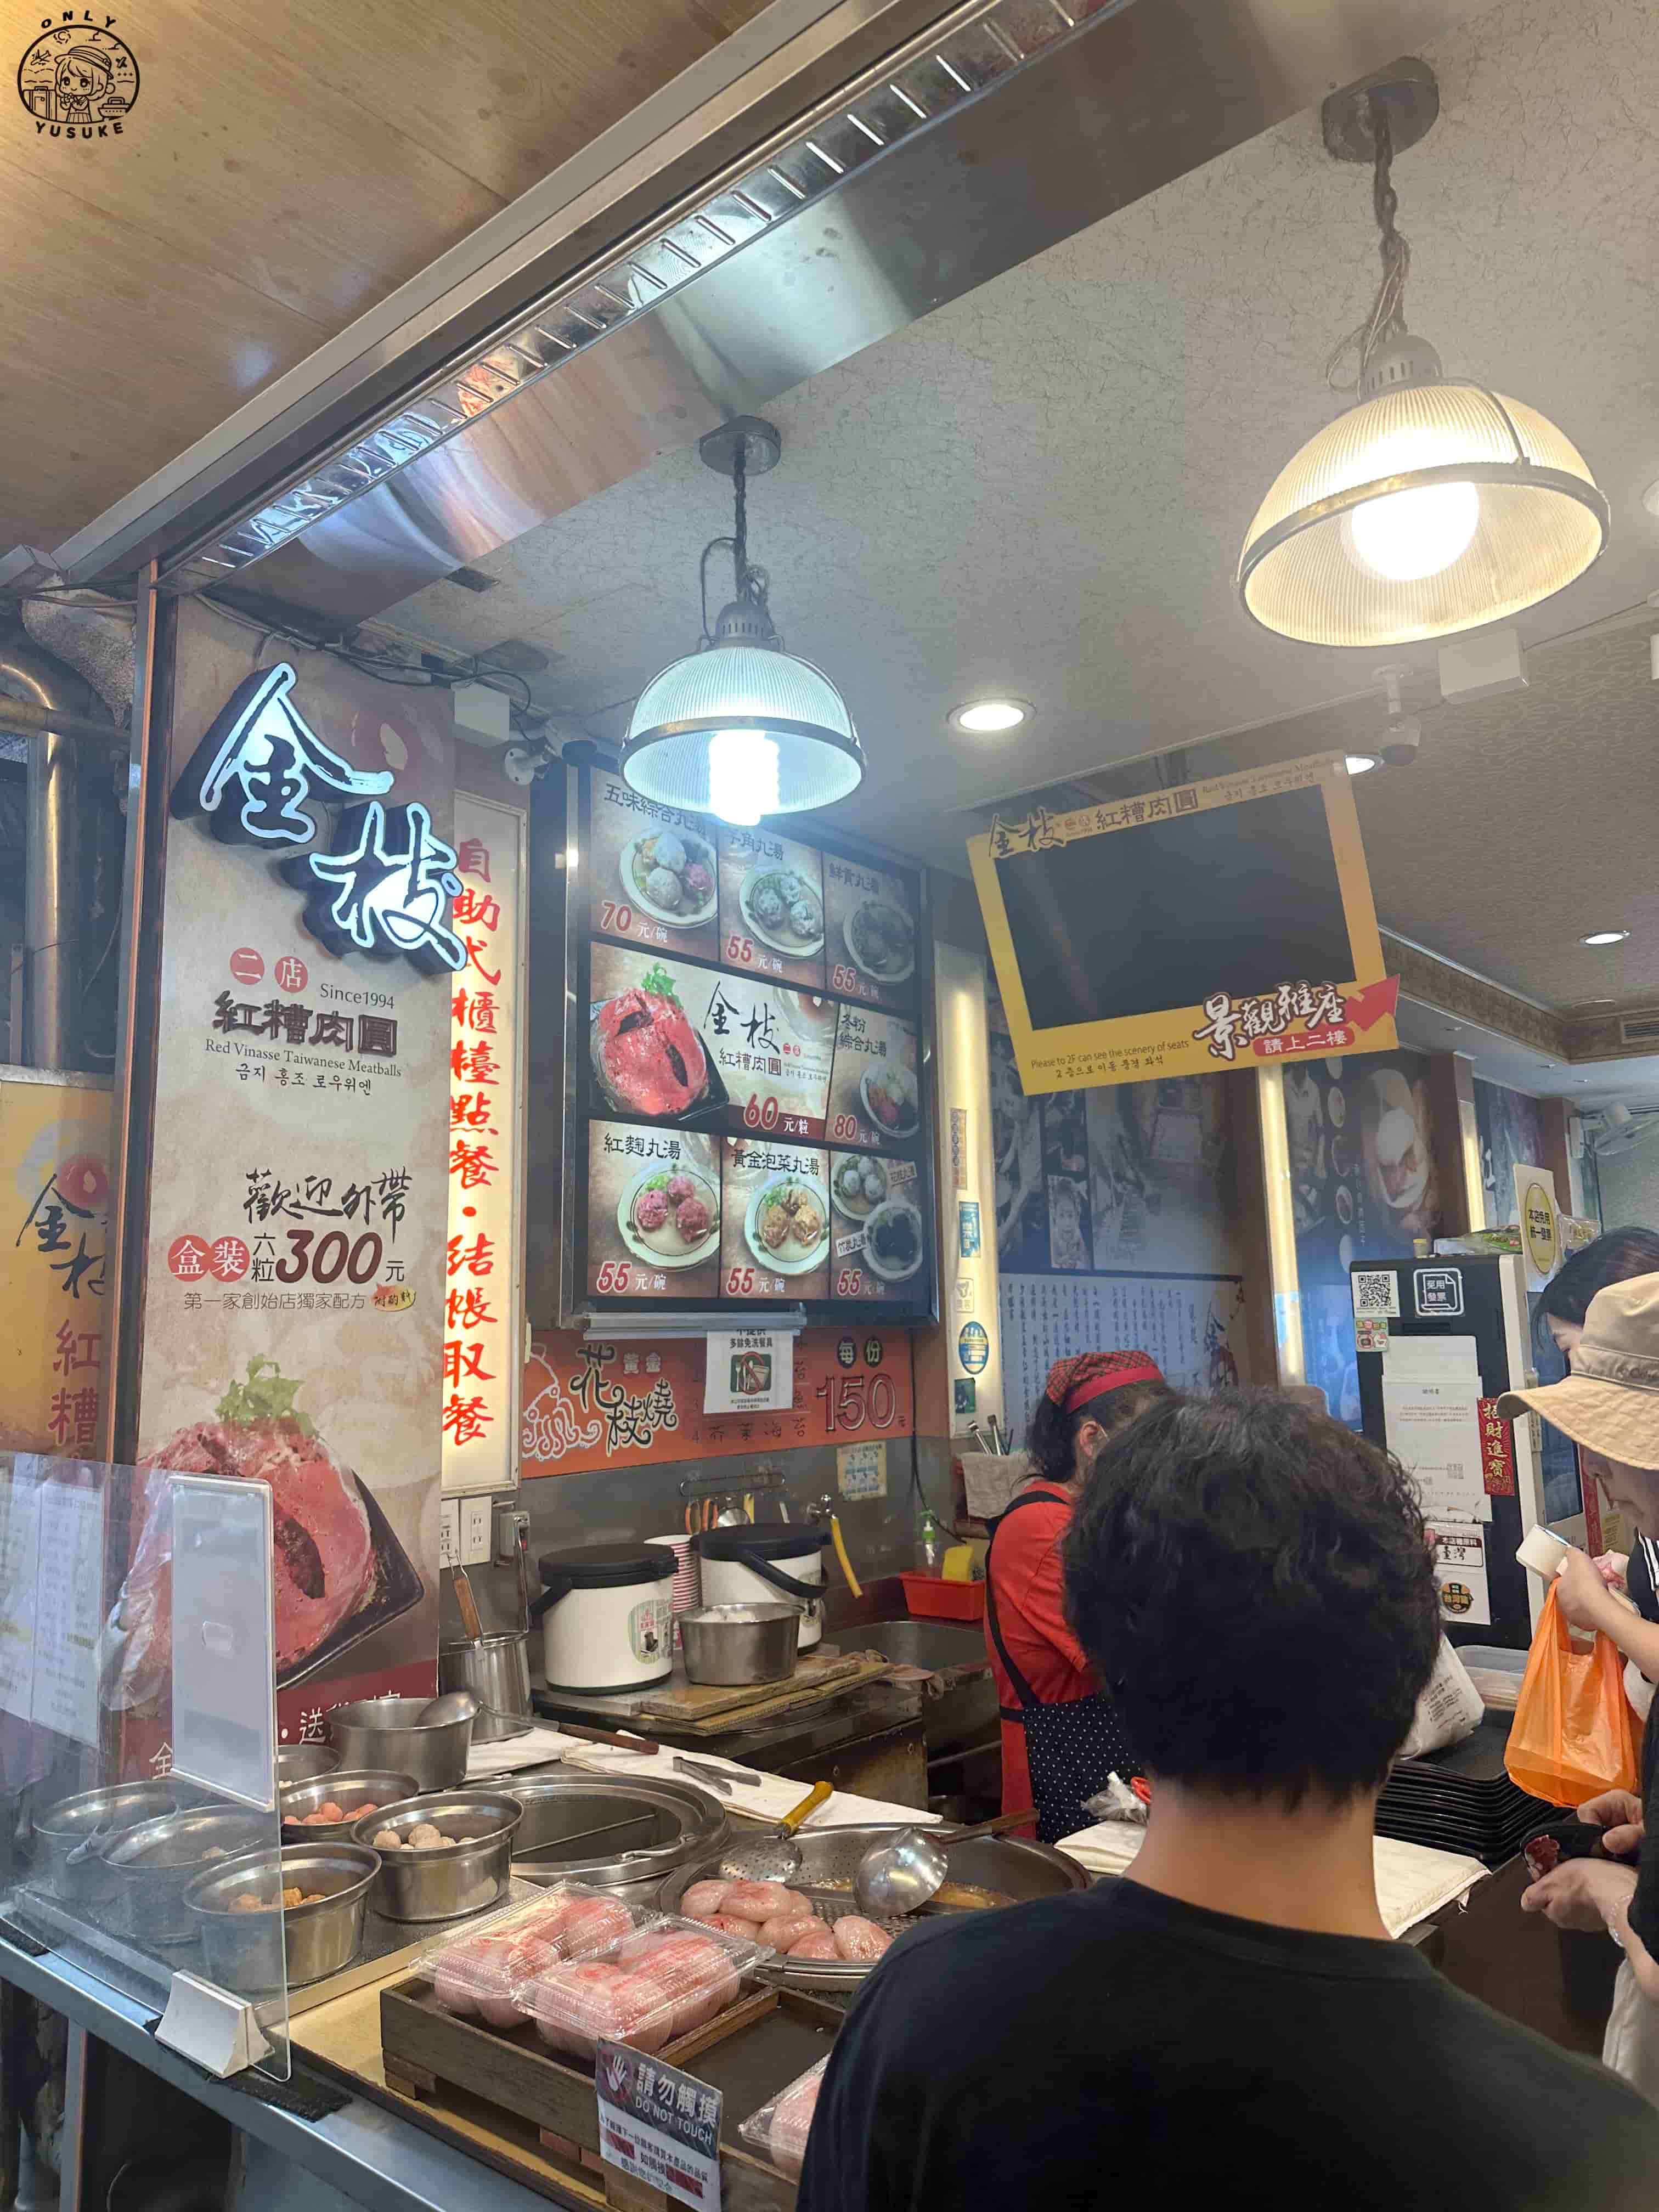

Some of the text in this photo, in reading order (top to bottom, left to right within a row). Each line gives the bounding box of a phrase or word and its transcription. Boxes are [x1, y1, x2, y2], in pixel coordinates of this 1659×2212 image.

[200, 661, 469, 971] 金枝
[988, 806, 1065, 857] 金枝
[601, 900, 632, 931] 70
[727, 934, 754, 963] 55
[233, 953, 304, 990] 二店
[833, 964, 856, 992] 55
[320, 983, 395, 1009] Since1994
[212, 990, 398, 1058] 紅糟肉圓
[704, 981, 781, 1054] 金枝
[1193, 982, 1345, 1060] 景觀雅座
[206, 1039, 402, 1077] Red Vinasse Taiwanese Meatballs
[1031, 1040, 1190, 1069] Please to 2F can see the scenery of seats
[1263, 1030, 1348, 1054] 請上二樓
[235, 1063, 266, 1082] 금지
[313, 1075, 371, 1096] 로우위엔
[718, 1047, 782, 1076] 紅糟肉圓
[743, 1093, 779, 1130] 60
[833, 1114, 857, 1141] 80
[731, 1149, 821, 1176] 黃金泡菜丸湯
[243, 1166, 413, 1245] 歡迎外帶
[171, 1237, 247, 1276] 盒裝
[252, 1233, 275, 1283] 六粒
[275, 1229, 405, 1284] 300 元
[597, 1261, 631, 1294] 55
[726, 1267, 755, 1295] 55
[837, 1268, 862, 1296] 55
[184, 1292, 366, 1310] 第一家創始店獨家配方
[838, 1339, 881, 1364] 每份
[816, 1373, 896, 1433] 150
[1483, 1402, 1508, 1478] 招財進寶
[636, 2062, 718, 2129] 請勿觸摸
[635, 2096, 713, 2146] DO NOT TOUCH
